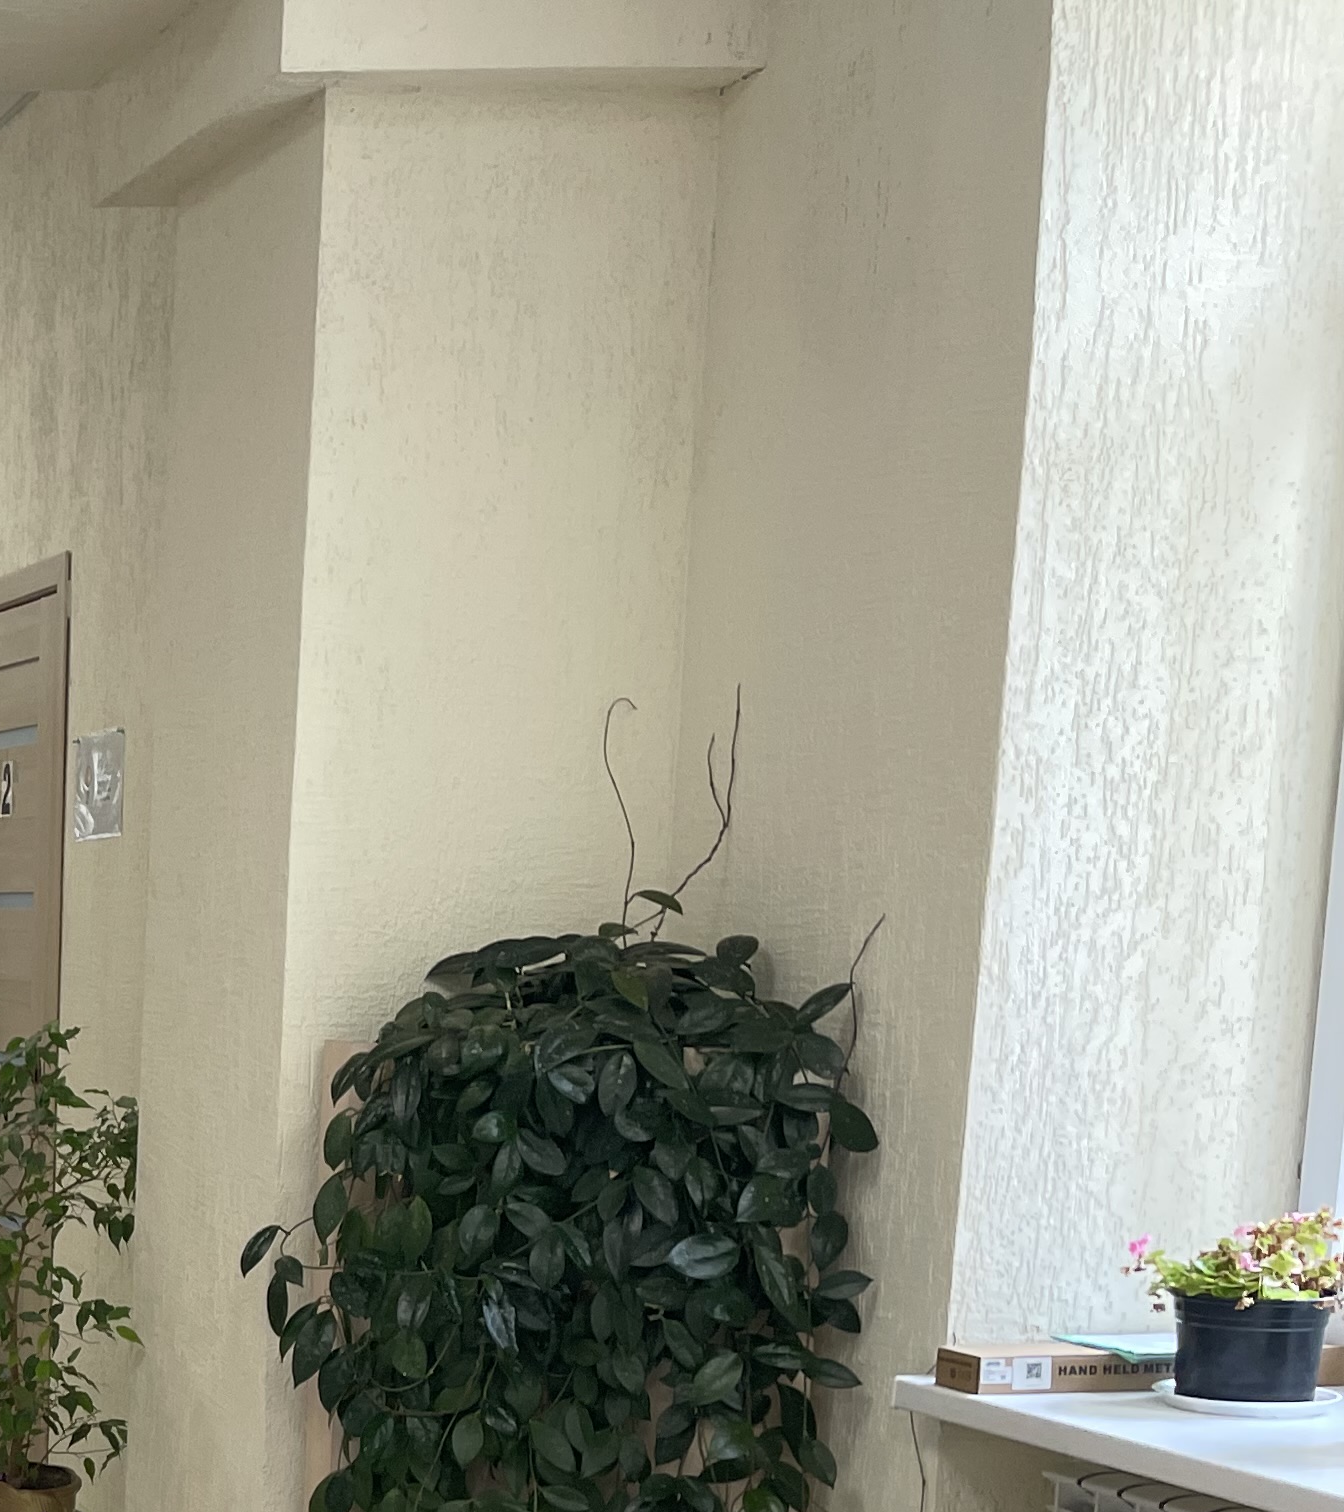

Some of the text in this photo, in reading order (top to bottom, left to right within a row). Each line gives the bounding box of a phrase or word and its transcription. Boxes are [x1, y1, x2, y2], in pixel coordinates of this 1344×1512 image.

[1, 763, 11, 815] 2
[1058, 1362, 1175, 1376] HAND HELD MET
